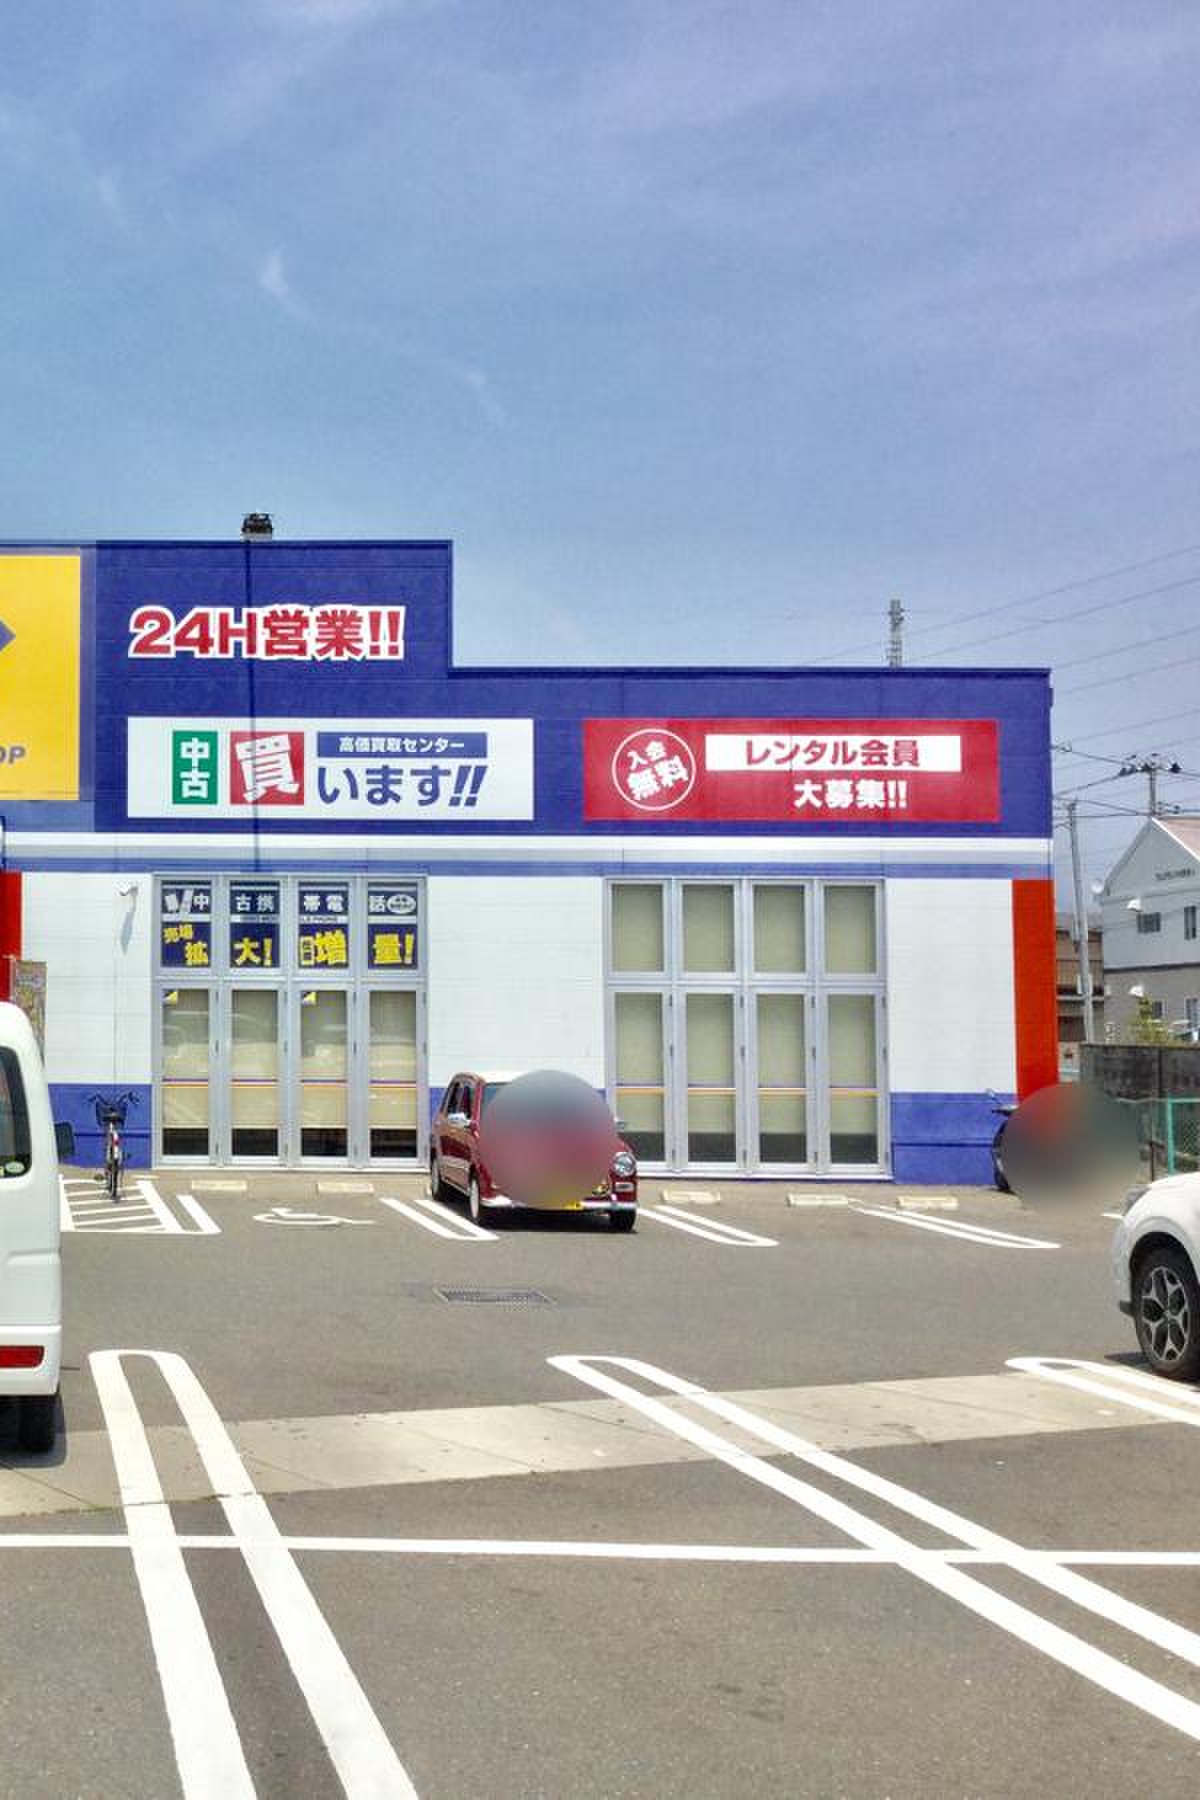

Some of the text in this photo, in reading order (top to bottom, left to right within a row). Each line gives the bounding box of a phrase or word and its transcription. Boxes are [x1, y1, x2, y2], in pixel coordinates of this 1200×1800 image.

[338, 736, 466, 754] 高価買取センター
[745, 740, 921, 767] レンタル会員
[180, 737, 210, 800] 中古
